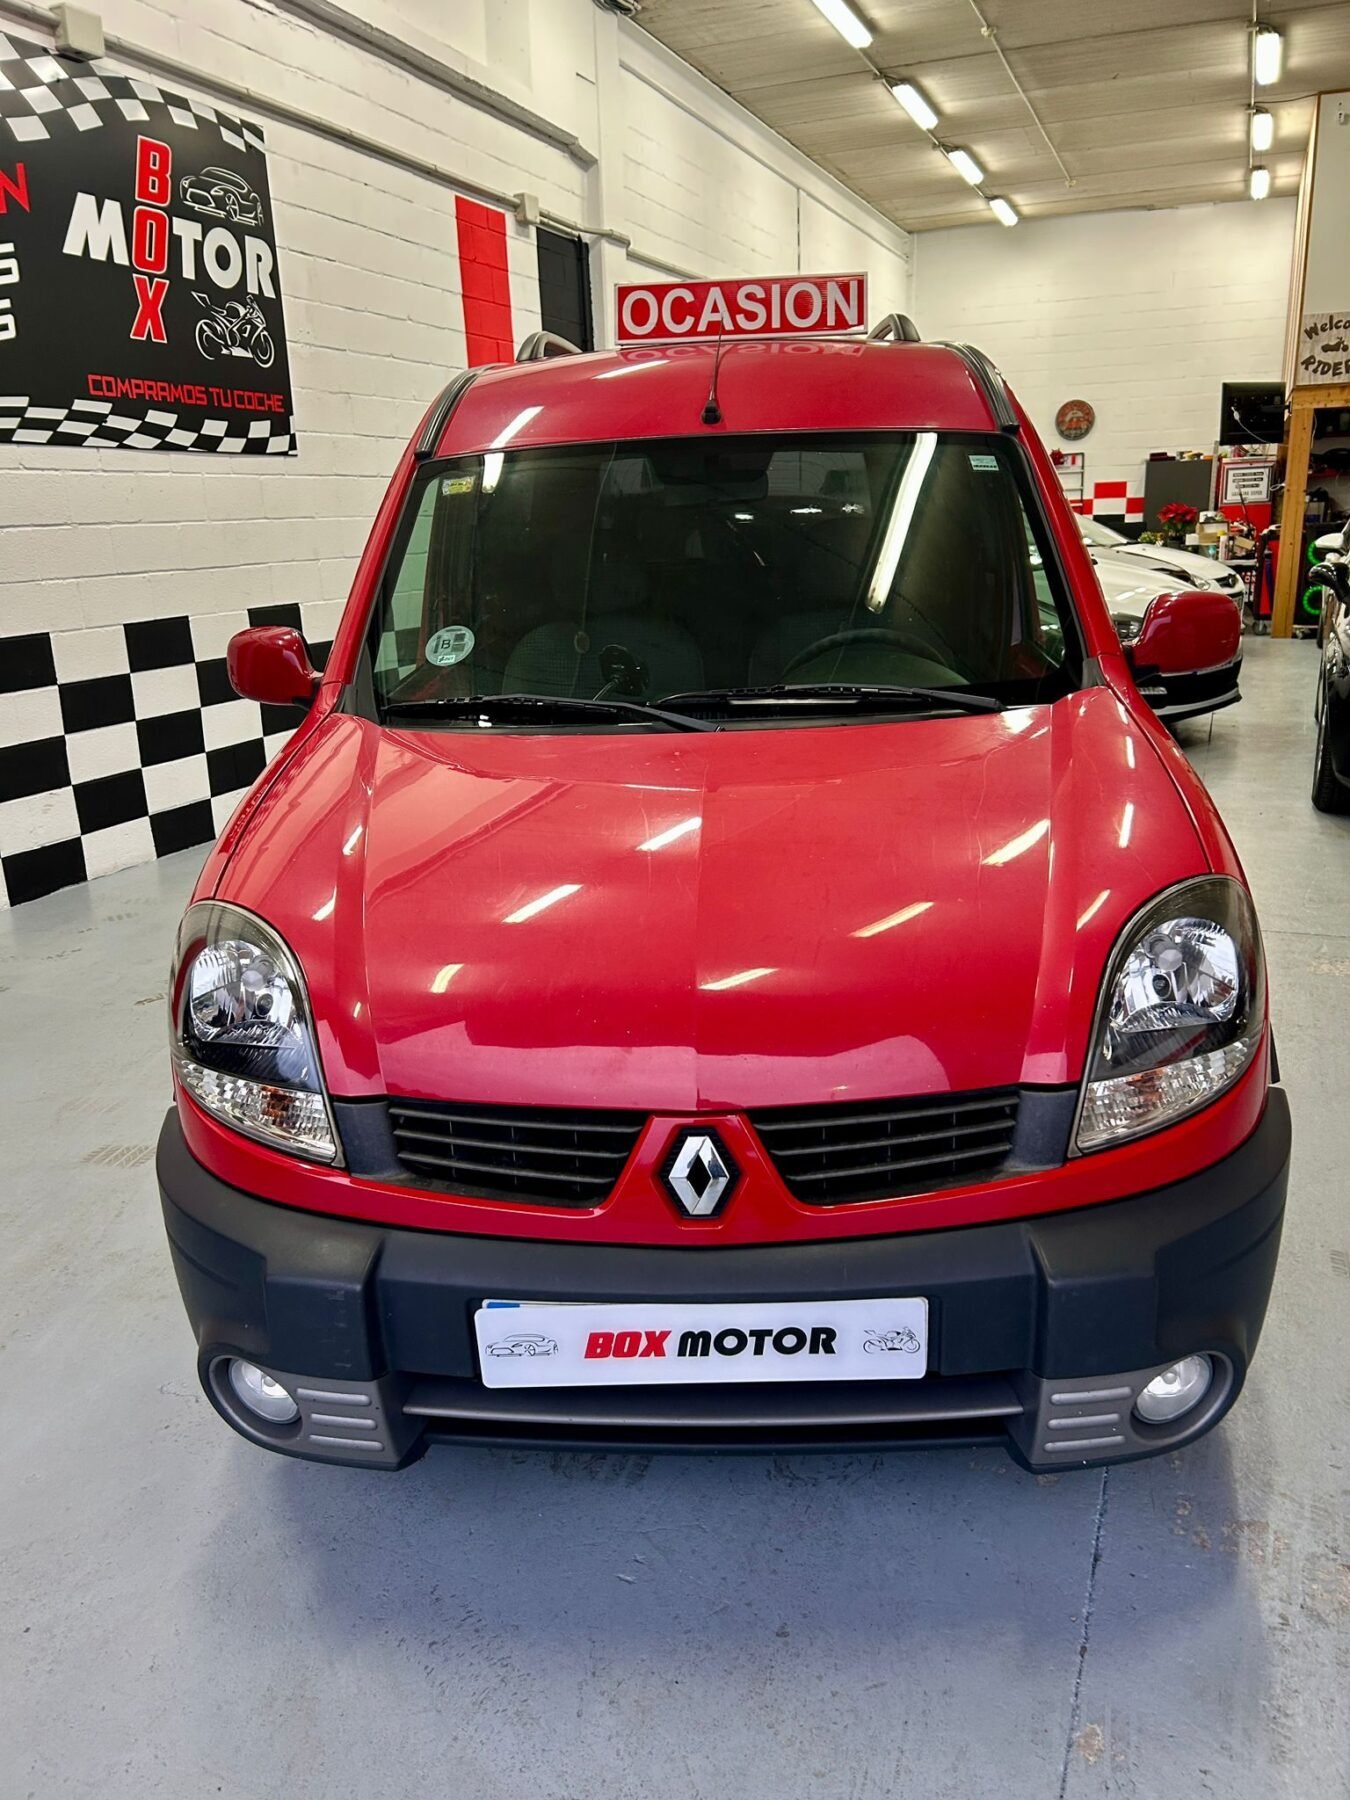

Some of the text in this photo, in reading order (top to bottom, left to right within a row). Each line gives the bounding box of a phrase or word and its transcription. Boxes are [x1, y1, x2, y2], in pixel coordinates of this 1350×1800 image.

[62, 191, 277, 299] MOTOR
[130, 135, 172, 344] BOX
[622, 280, 859, 335] OCASION
[87, 374, 285, 412] COMPRAMOS TU COCHE
[584, 1326, 837, 1359] BOX MOTOR
